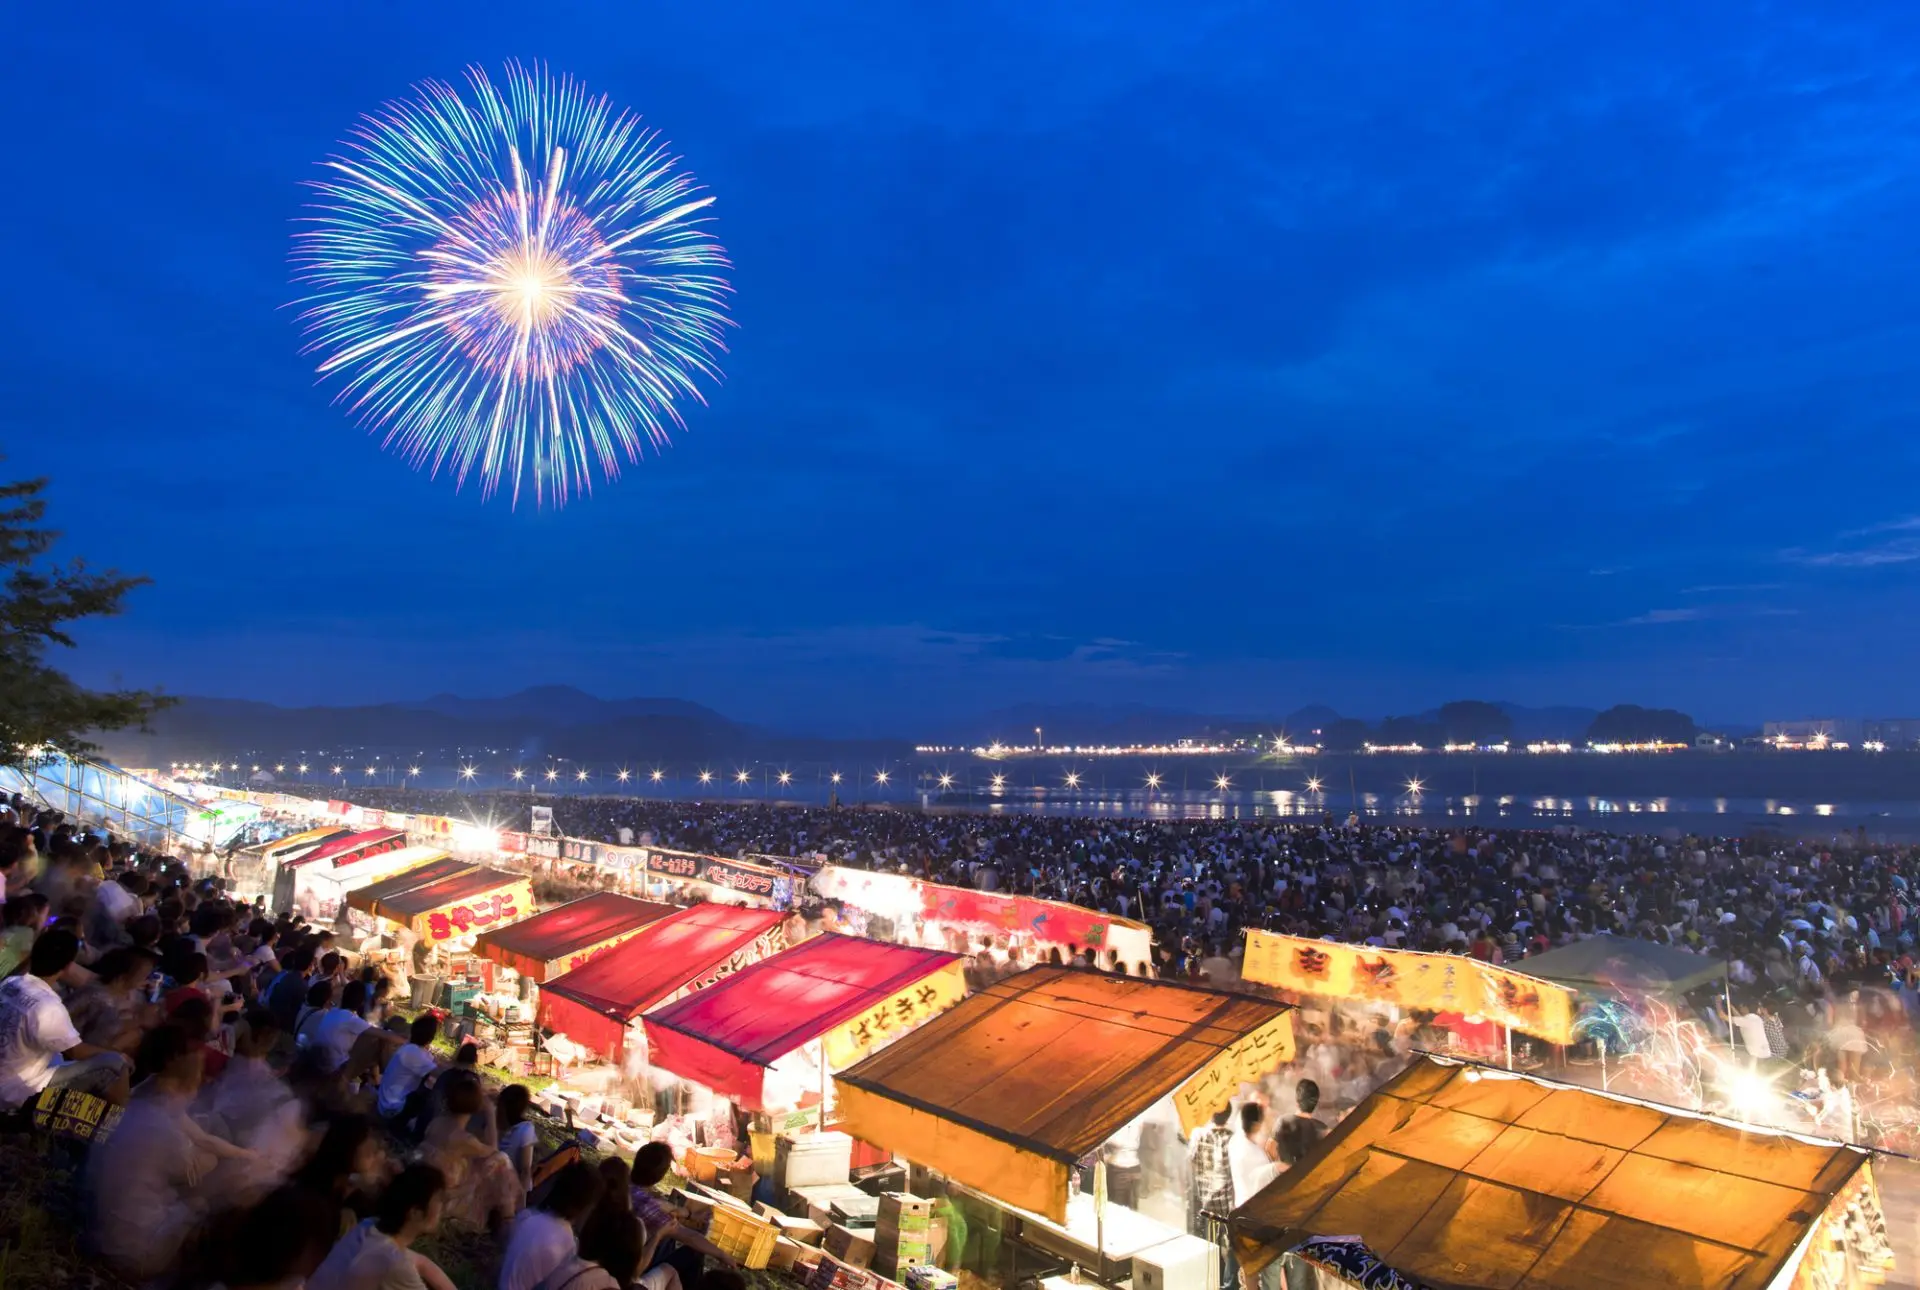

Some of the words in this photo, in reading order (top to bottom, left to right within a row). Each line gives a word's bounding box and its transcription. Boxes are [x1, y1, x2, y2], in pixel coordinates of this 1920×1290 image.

[707, 865, 773, 893] ベビーカステラ
